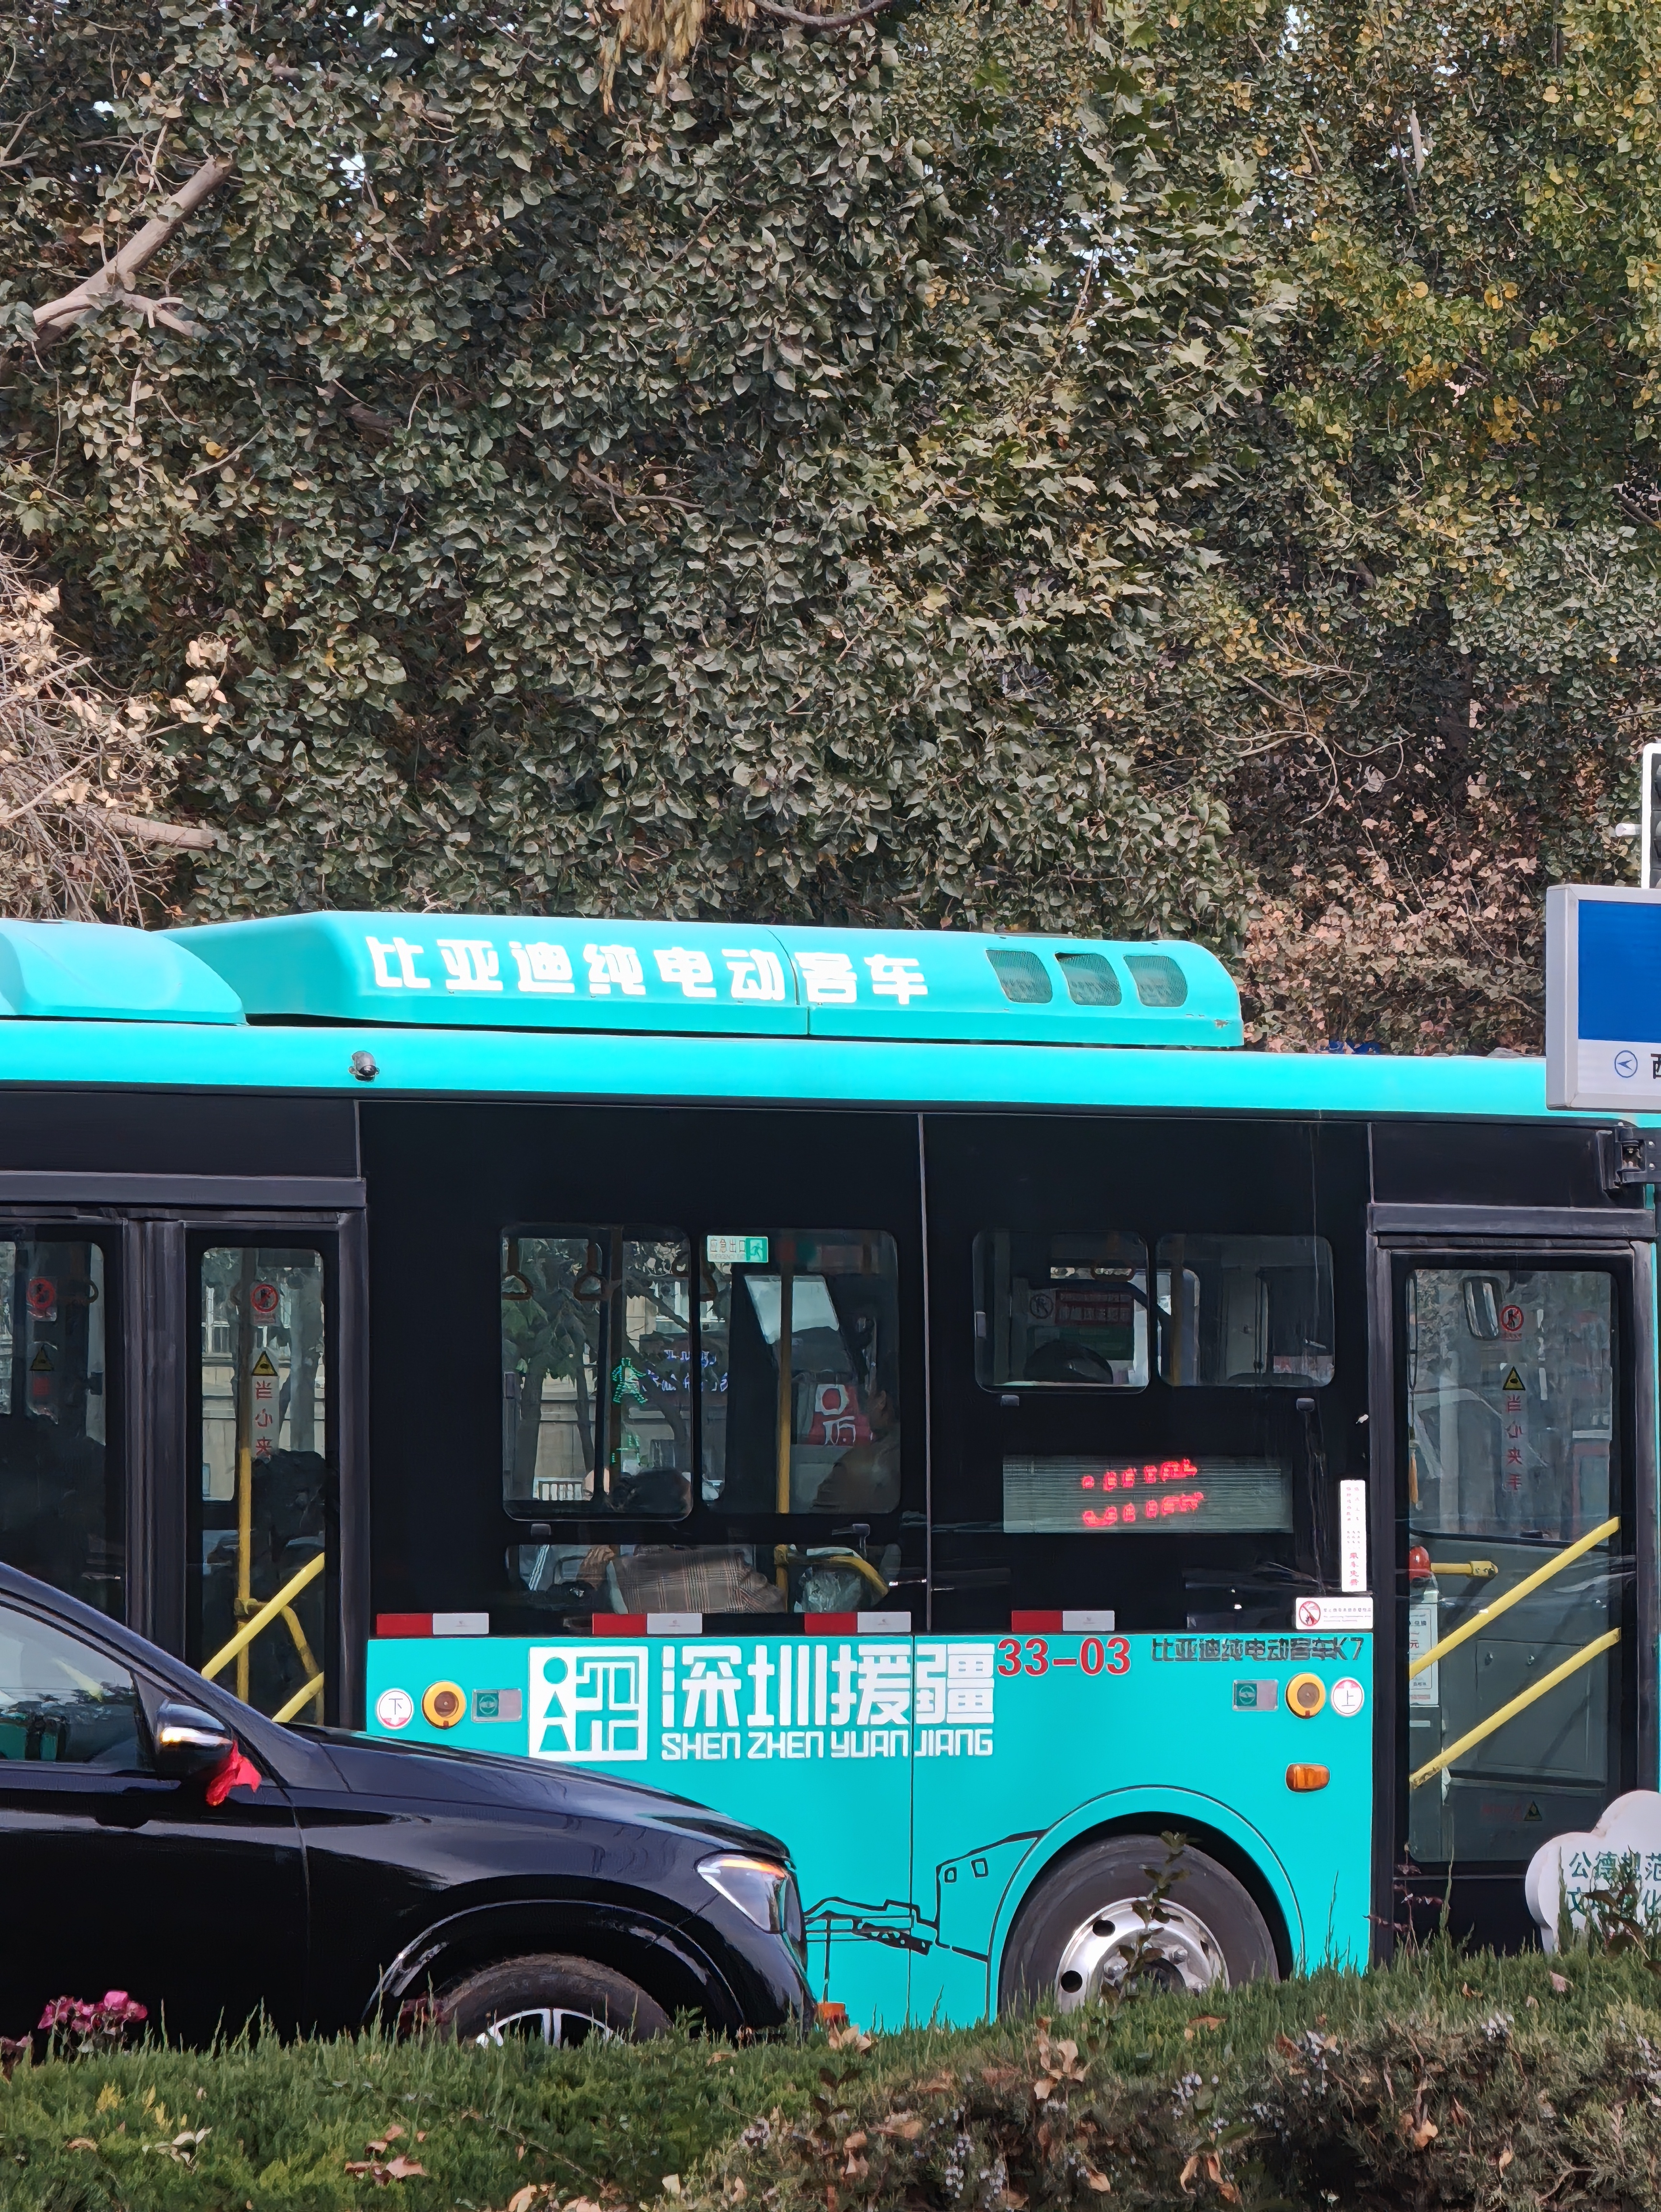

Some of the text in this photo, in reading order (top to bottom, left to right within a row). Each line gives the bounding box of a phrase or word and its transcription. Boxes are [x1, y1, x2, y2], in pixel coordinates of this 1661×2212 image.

[365, 936, 928, 1005] 比亚迪纯电动客车
[997, 1637, 1131, 1676] 33-03
[662, 1644, 995, 1727] 深圳援疆
[1341, 1690, 1355, 1706] 上
[388, 1698, 403, 1715] 下
[662, 1729, 993, 1760] SHEN ZHEN YUAN JIANG
